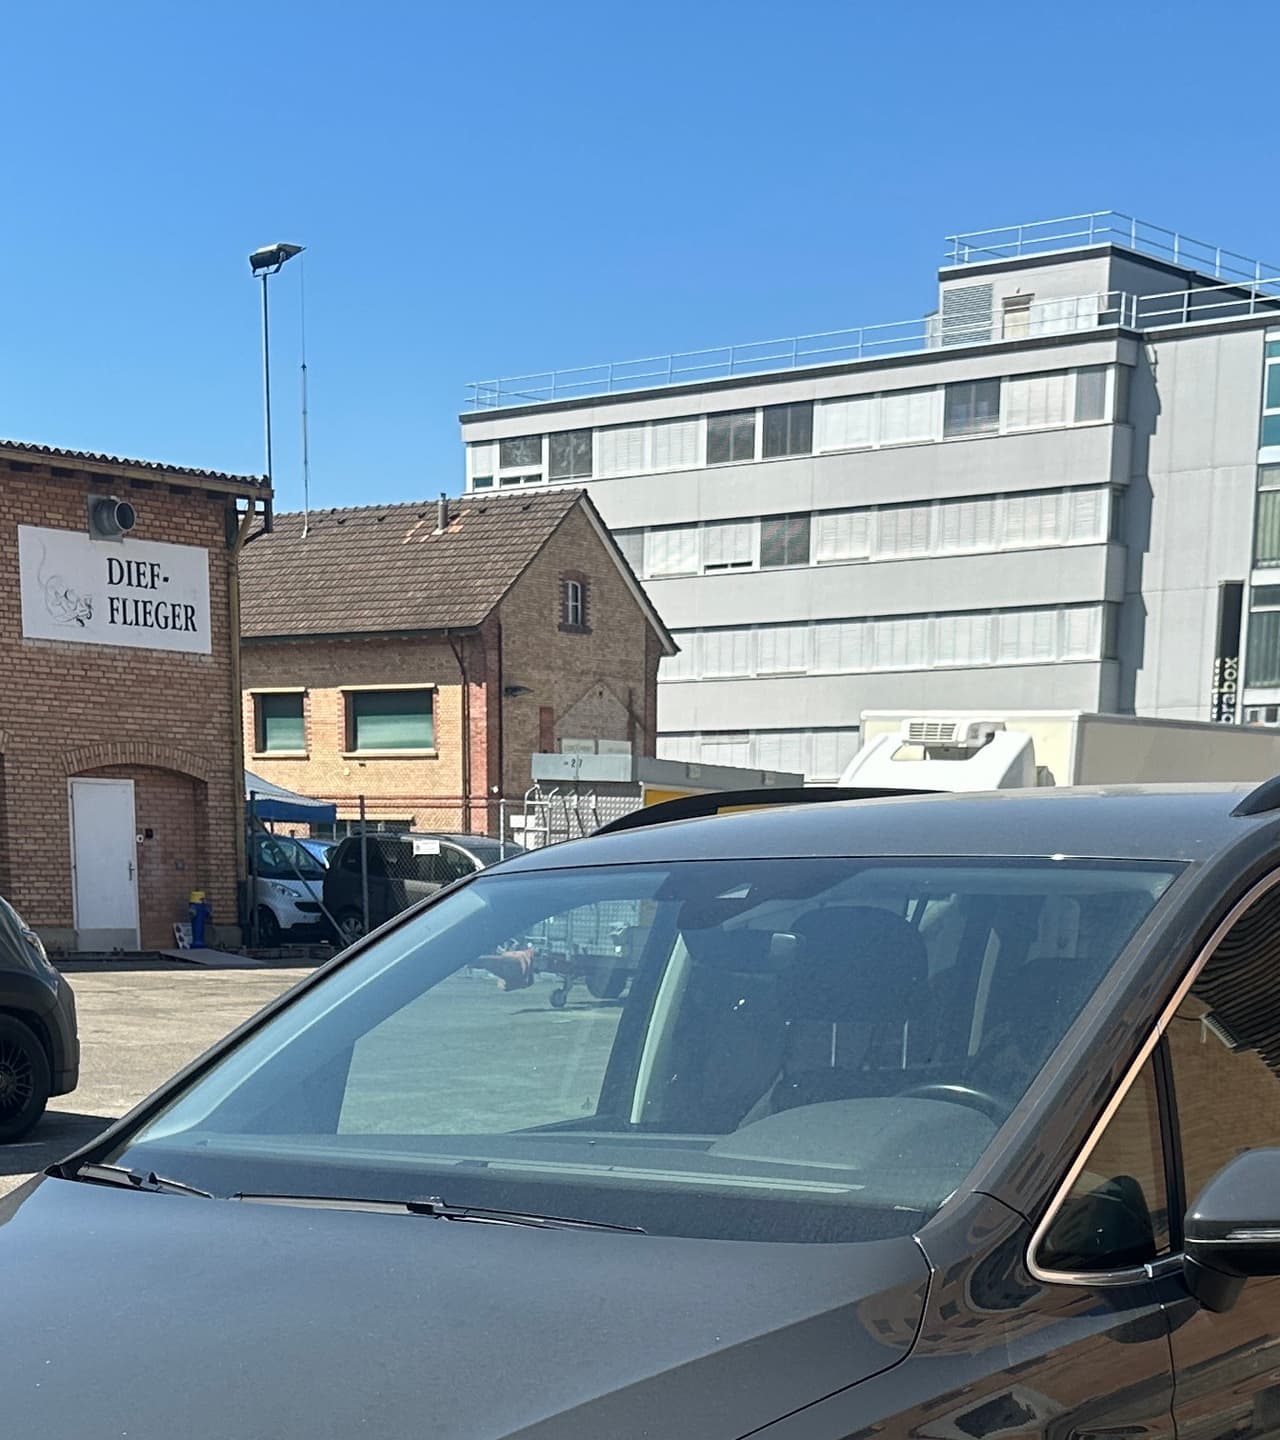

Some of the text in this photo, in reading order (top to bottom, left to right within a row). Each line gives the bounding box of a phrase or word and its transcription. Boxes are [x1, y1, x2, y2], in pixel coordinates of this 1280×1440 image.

[106, 557, 169, 590] DIEF-
[108, 596, 198, 632] FLIEGER
[1220, 657, 1238, 724] brabox
